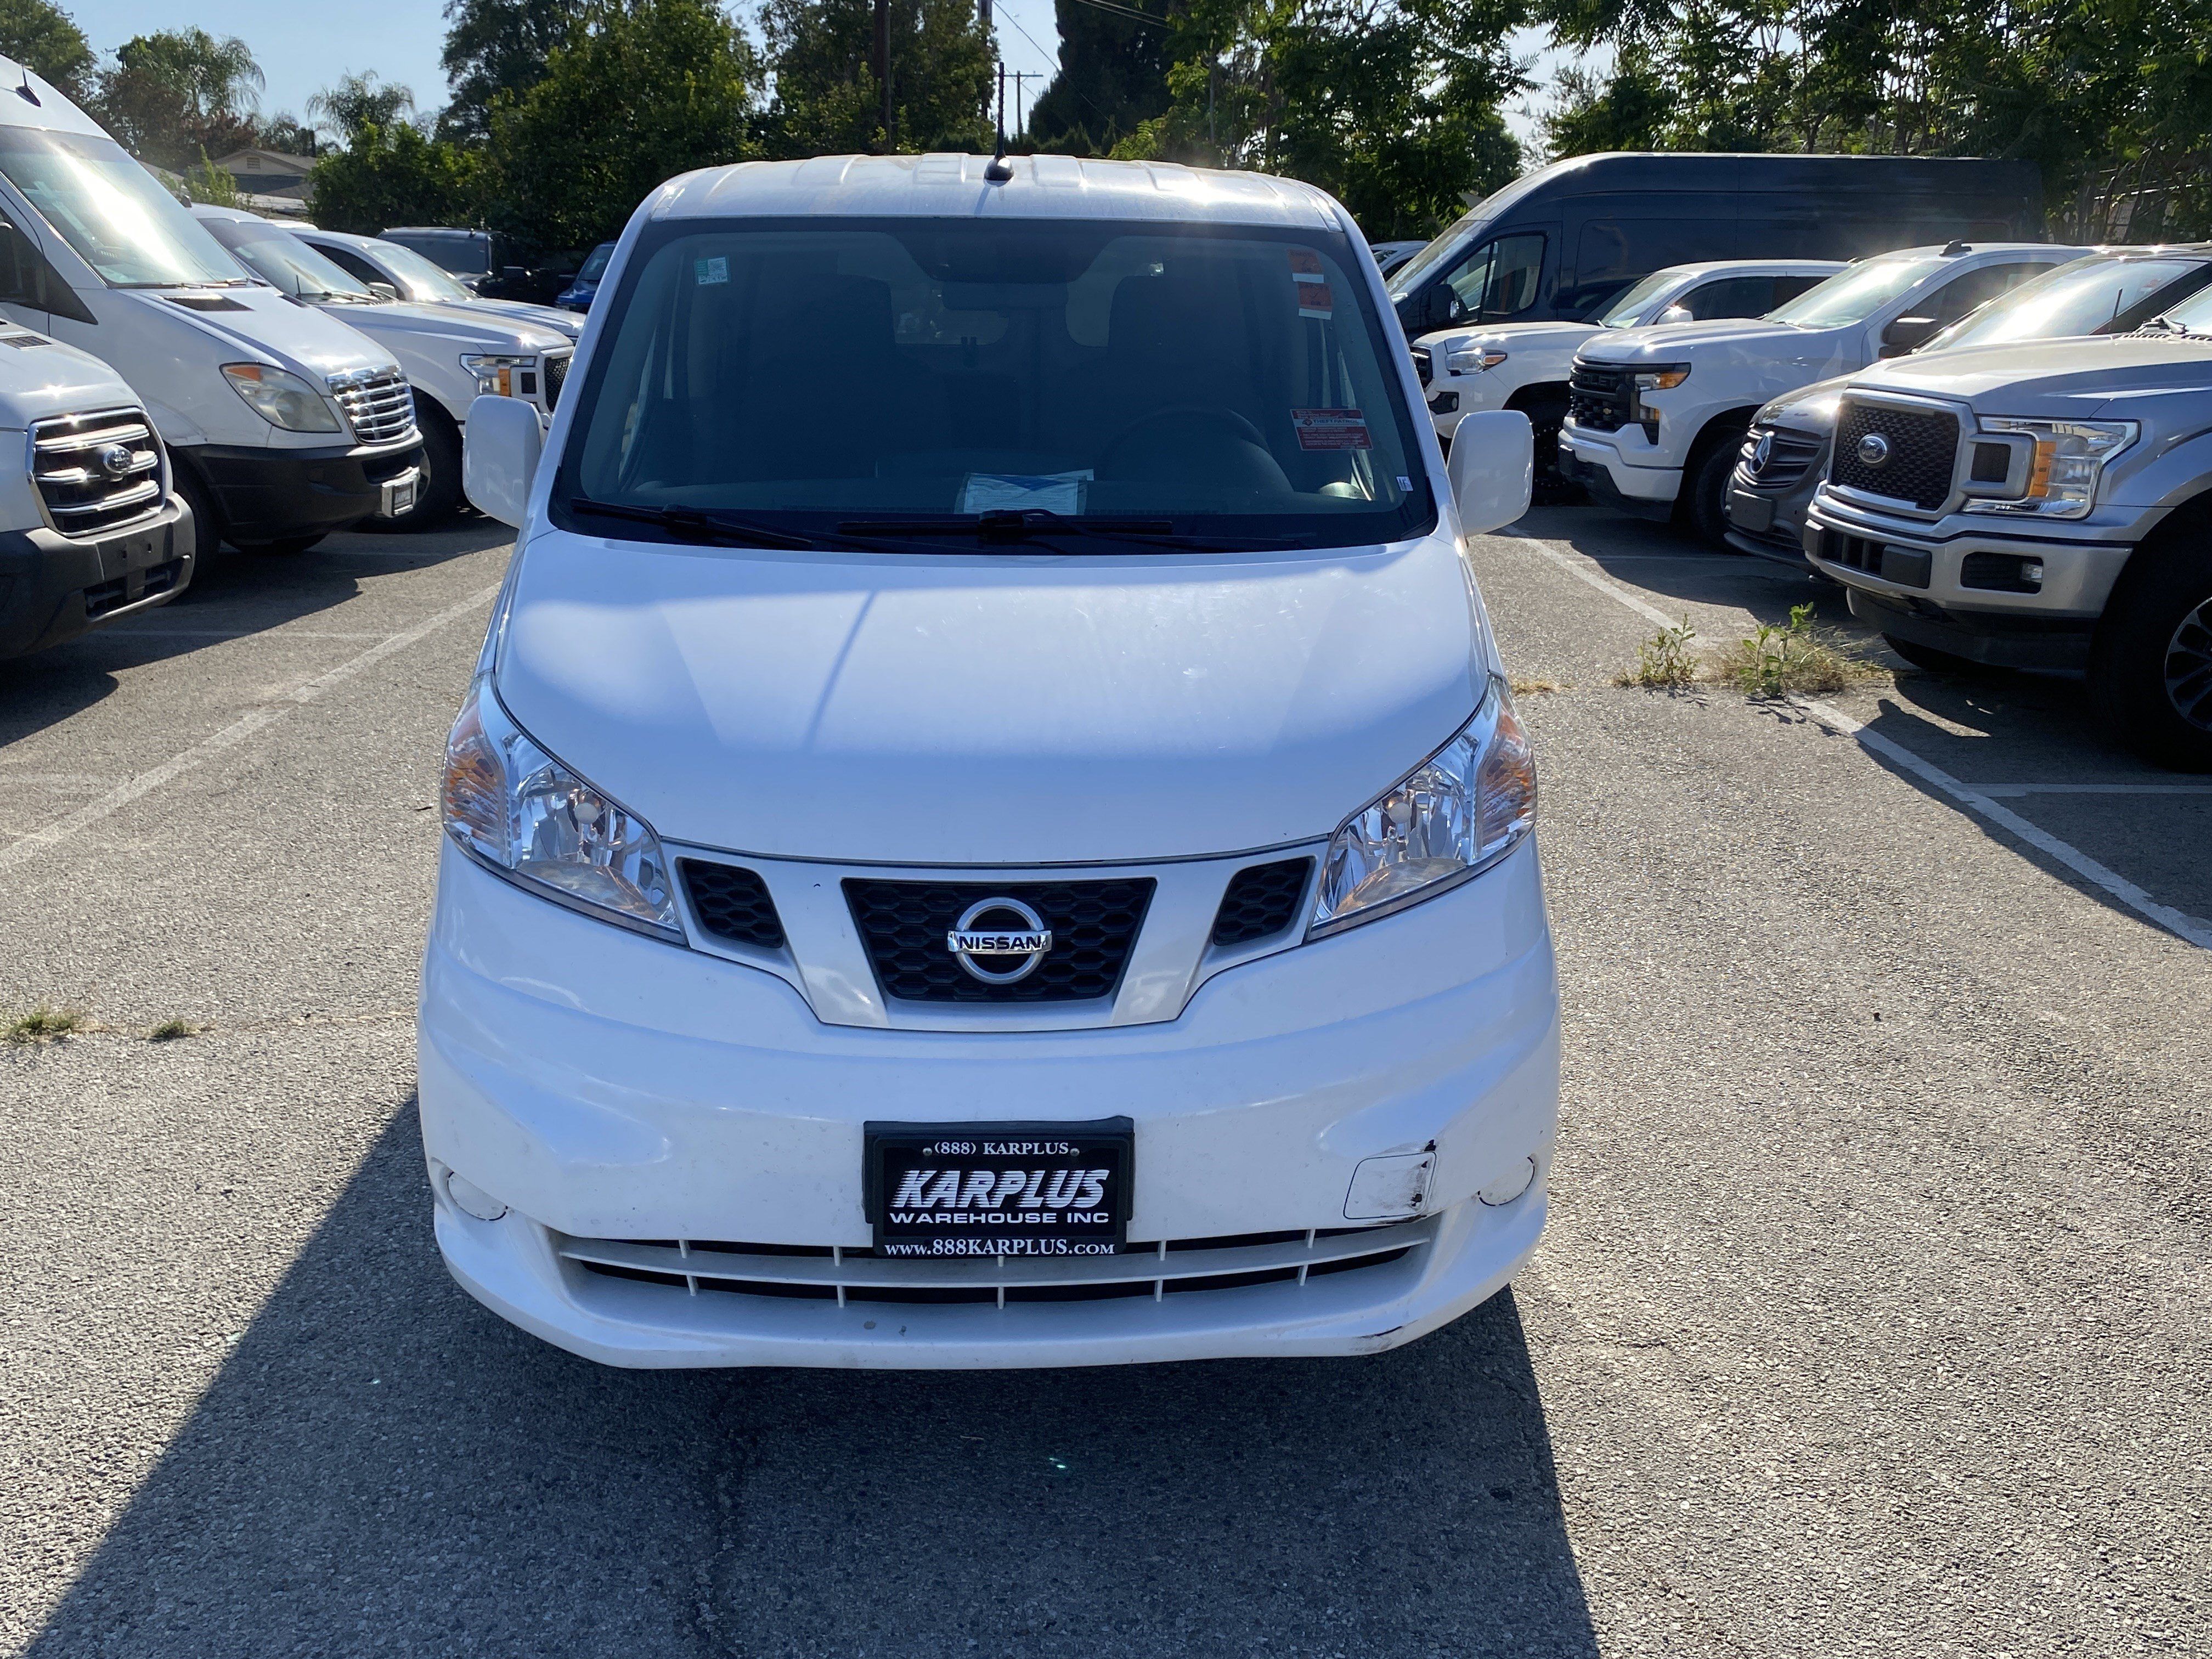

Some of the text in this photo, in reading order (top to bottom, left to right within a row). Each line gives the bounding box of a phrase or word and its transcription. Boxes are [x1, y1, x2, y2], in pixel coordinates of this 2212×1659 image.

[959, 935, 1041, 950] NISSAN
[934, 1142, 1069, 1155] (888) KARPLUS
[890, 1169, 1110, 1208] KARPLUS
[889, 1212, 1109, 1223] WAREHOUSE INC
